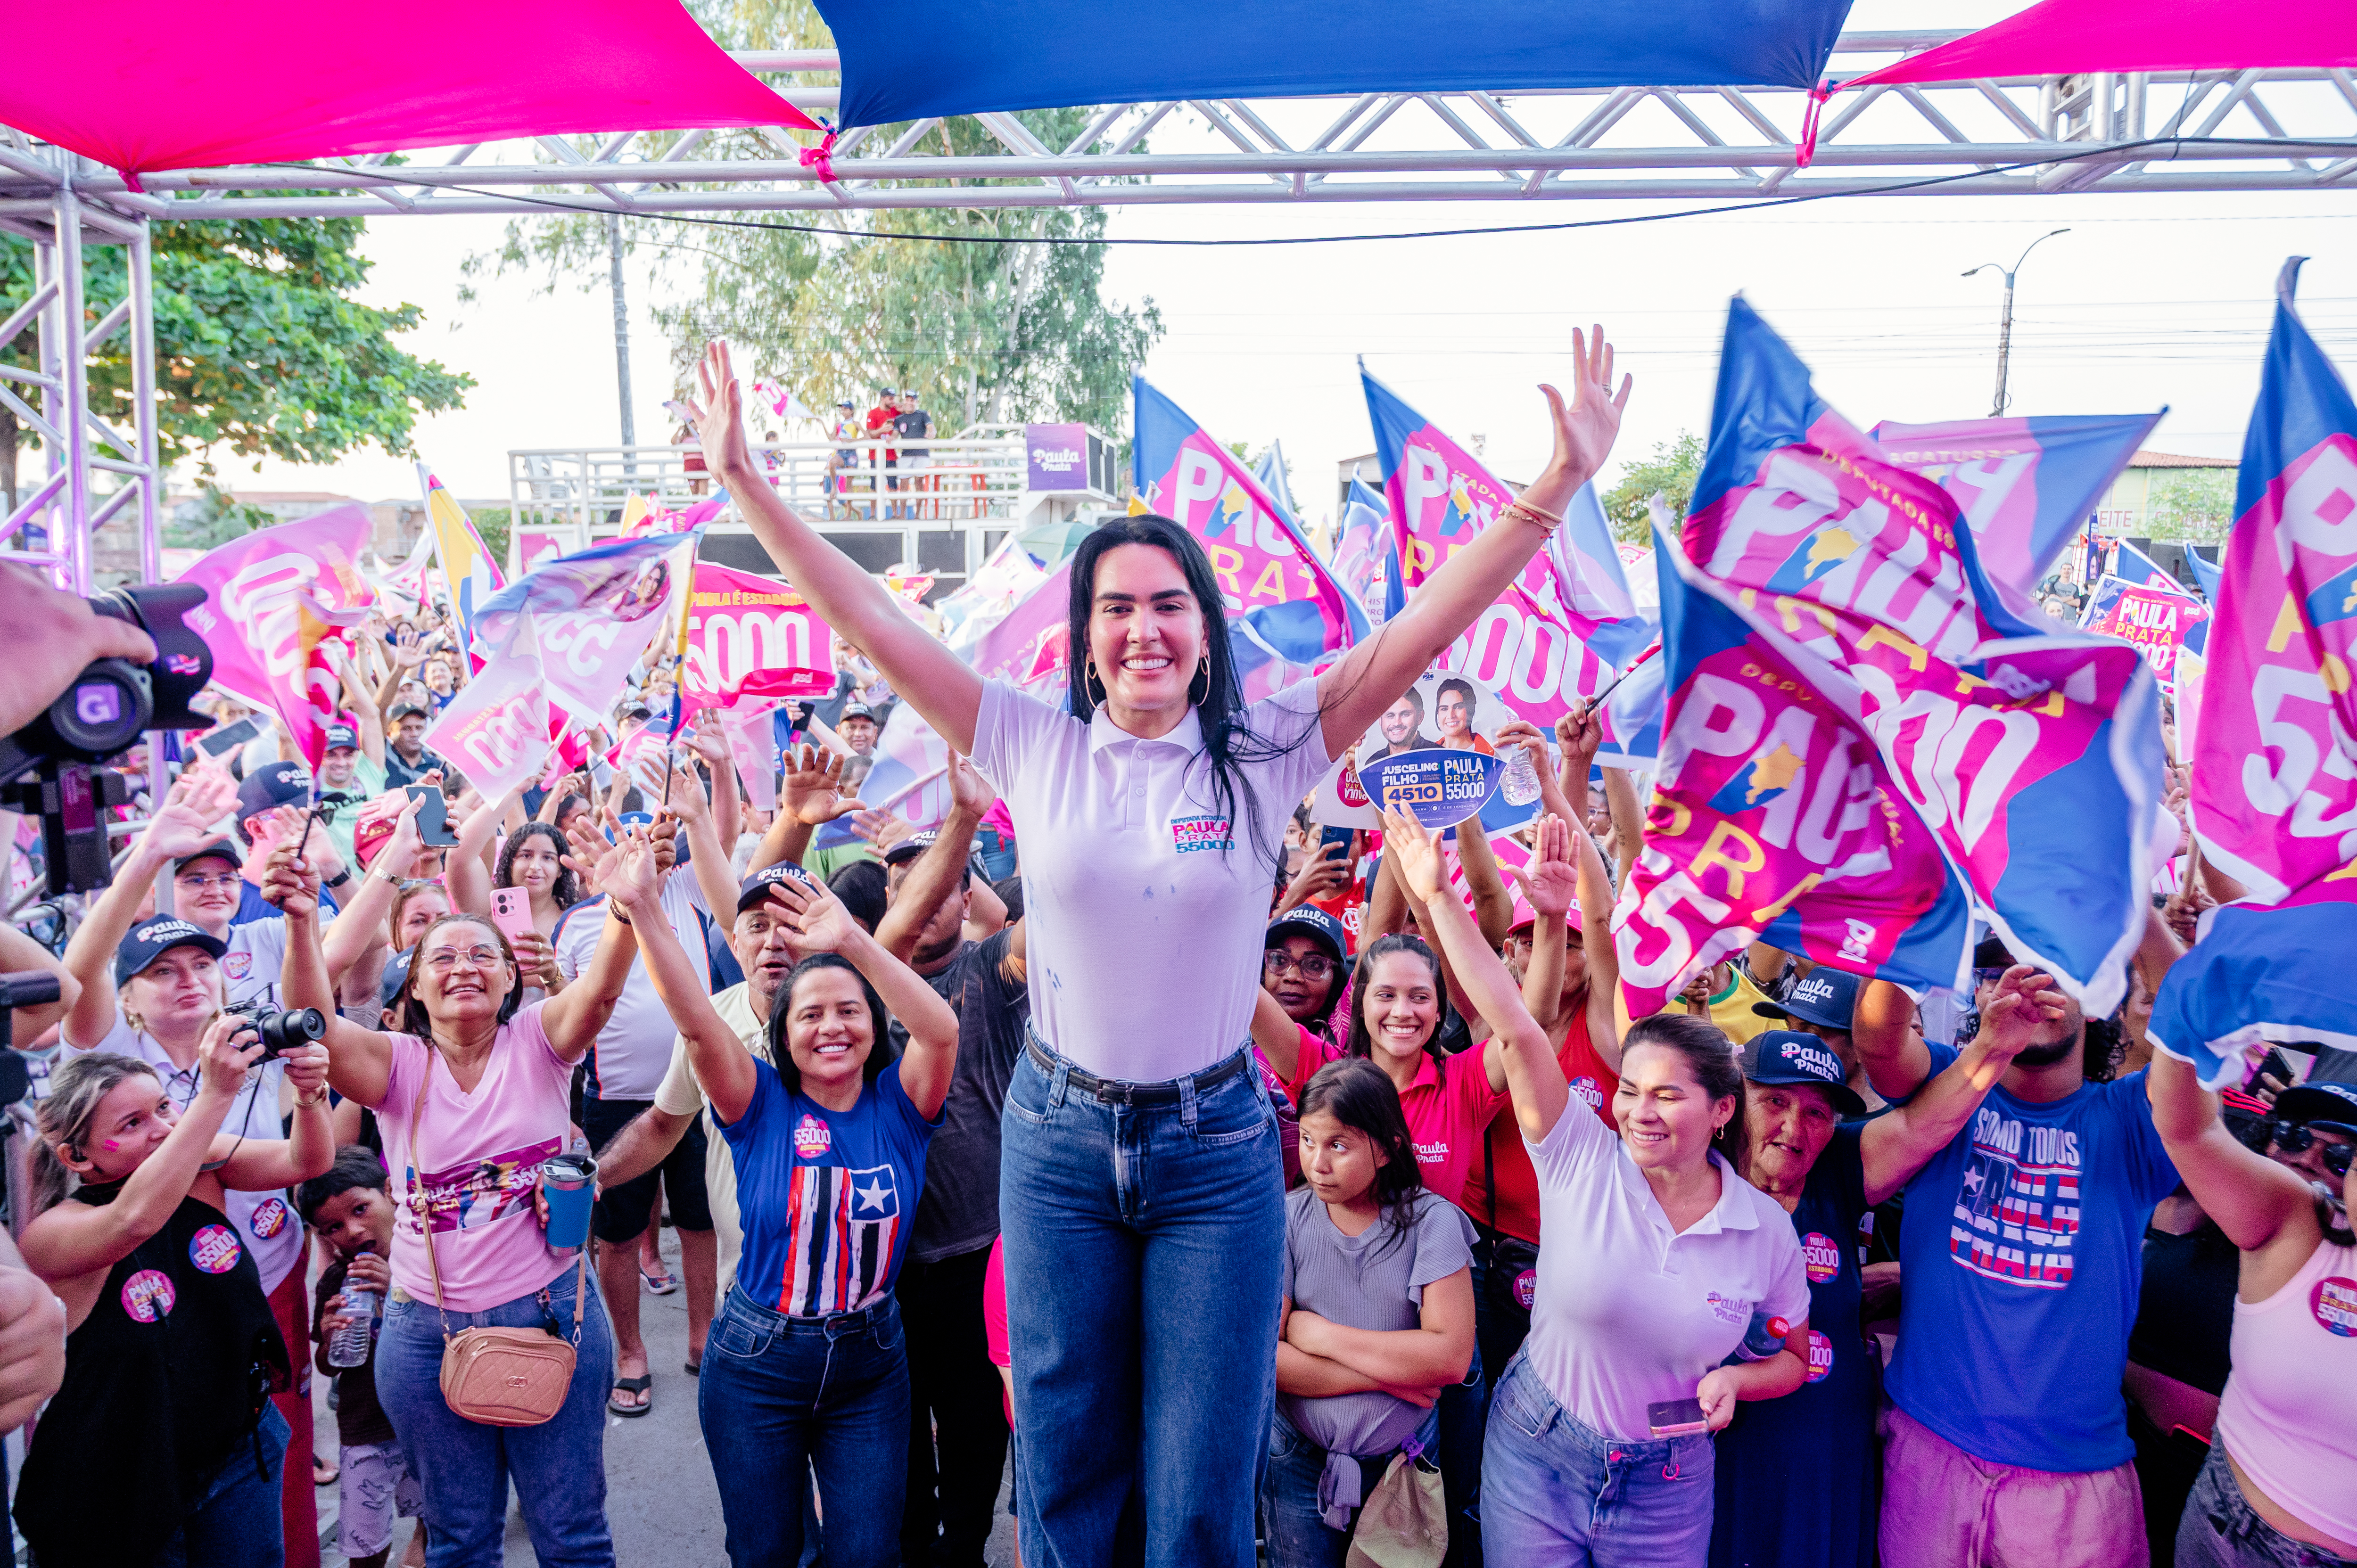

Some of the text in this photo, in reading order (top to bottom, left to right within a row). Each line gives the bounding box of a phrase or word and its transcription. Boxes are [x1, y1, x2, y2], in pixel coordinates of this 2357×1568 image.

[1032, 448, 1080, 464] Paula
[1041, 463, 1072, 472] Prata
[690, 589, 806, 607] PAULA É ESTADUA
[2118, 598, 2176, 632] PAULA
[2184, 607, 2200, 616] psd
[2115, 622, 2172, 645] PRATA
[1450, 603, 1615, 711] 000
[2132, 641, 2170, 671] 00
[792, 673, 813, 684] psd
[1382, 762, 1439, 775] JUSCELINO
[1444, 757, 1484, 775] PAULA
[1382, 774, 1418, 786] FILHO
[1445, 773, 1484, 783] PRATA
[1389, 786, 1437, 801] 4510
[1446, 781, 1484, 800] 55000
[1170, 816, 1200, 824] DEPUTADA
[1172, 821, 1230, 836] PAULA
[908, 830, 939, 842] Pau
[1174, 833, 1234, 843] PRATA
[1176, 840, 1235, 853] 55000
[1282, 909, 1329, 928] Paula
[137, 919, 200, 942] Paula
[1836, 917, 1876, 964] psd
[1797, 978, 1834, 999] aula
[1781, 1042, 1839, 1079] Paula
[1794, 1059, 1833, 1082] Prata
[794, 1127, 831, 1146] 55000
[1973, 1108, 2080, 1166] SOMO TODOS
[1411, 1141, 1449, 1154] Paula
[1416, 1154, 1444, 1164] Prata
[254, 1199, 283, 1237] 55000
[194, 1231, 238, 1268] 55000
[128, 1276, 163, 1300] PAULA
[1518, 1277, 1536, 1289] PAU
[1522, 1293, 1534, 1305] 55
[1707, 1291, 1748, 1315] Paula
[1714, 1307, 1742, 1324] Prata
[1810, 1346, 1831, 1366] 000
